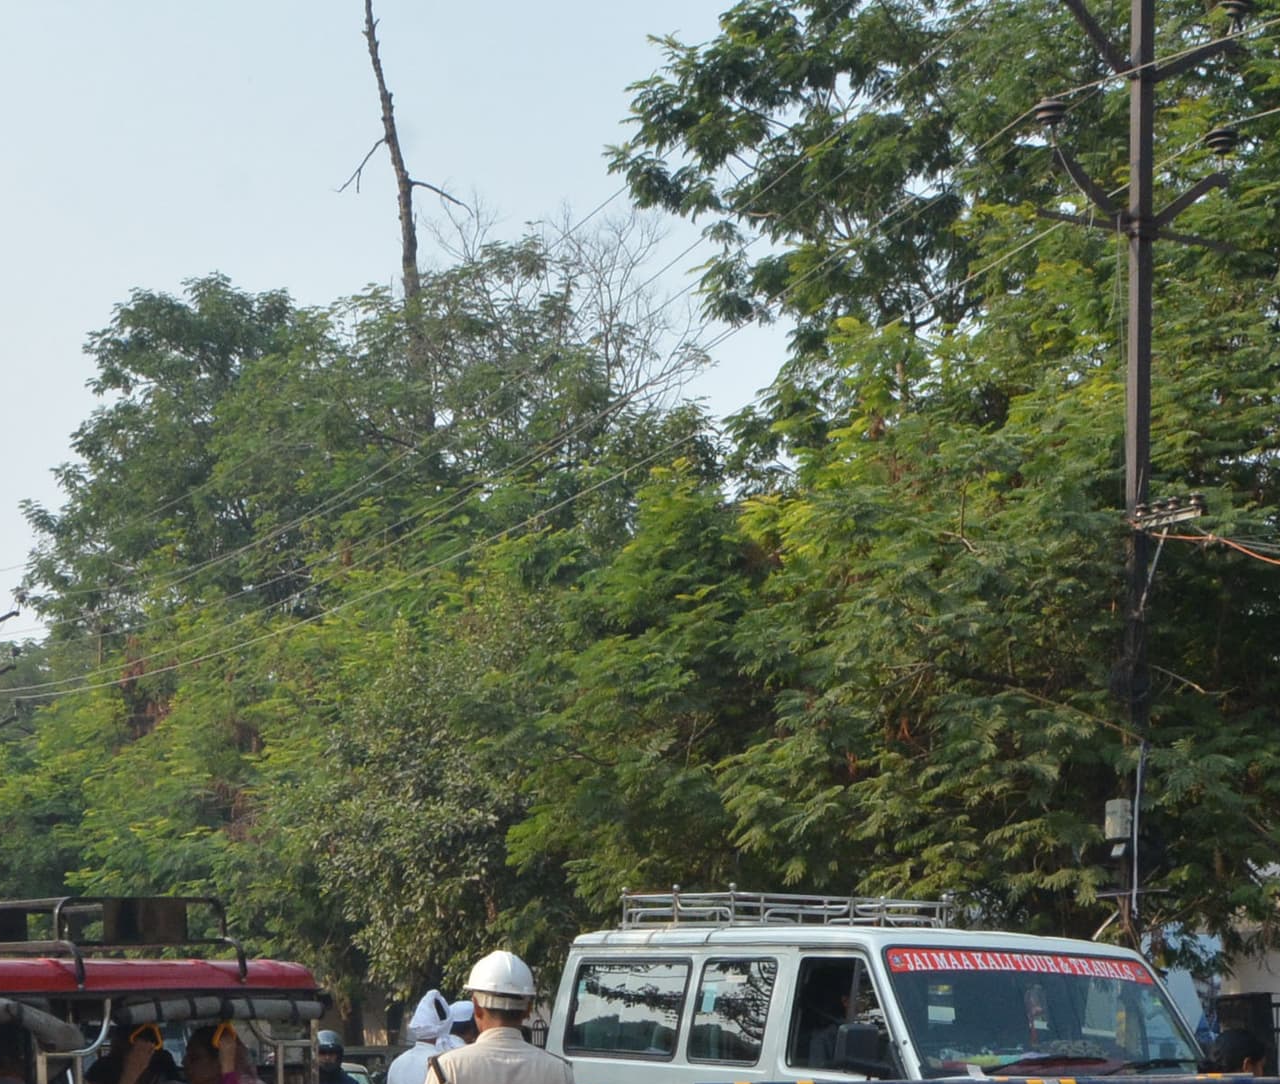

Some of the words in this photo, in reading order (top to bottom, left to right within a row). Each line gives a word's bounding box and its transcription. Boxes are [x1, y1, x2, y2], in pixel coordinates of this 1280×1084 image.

[904, 953, 933, 971] JAI
[931, 952, 974, 970] MAA
[971, 953, 1017, 970] KALI
[1011, 954, 1060, 972] TOUR
